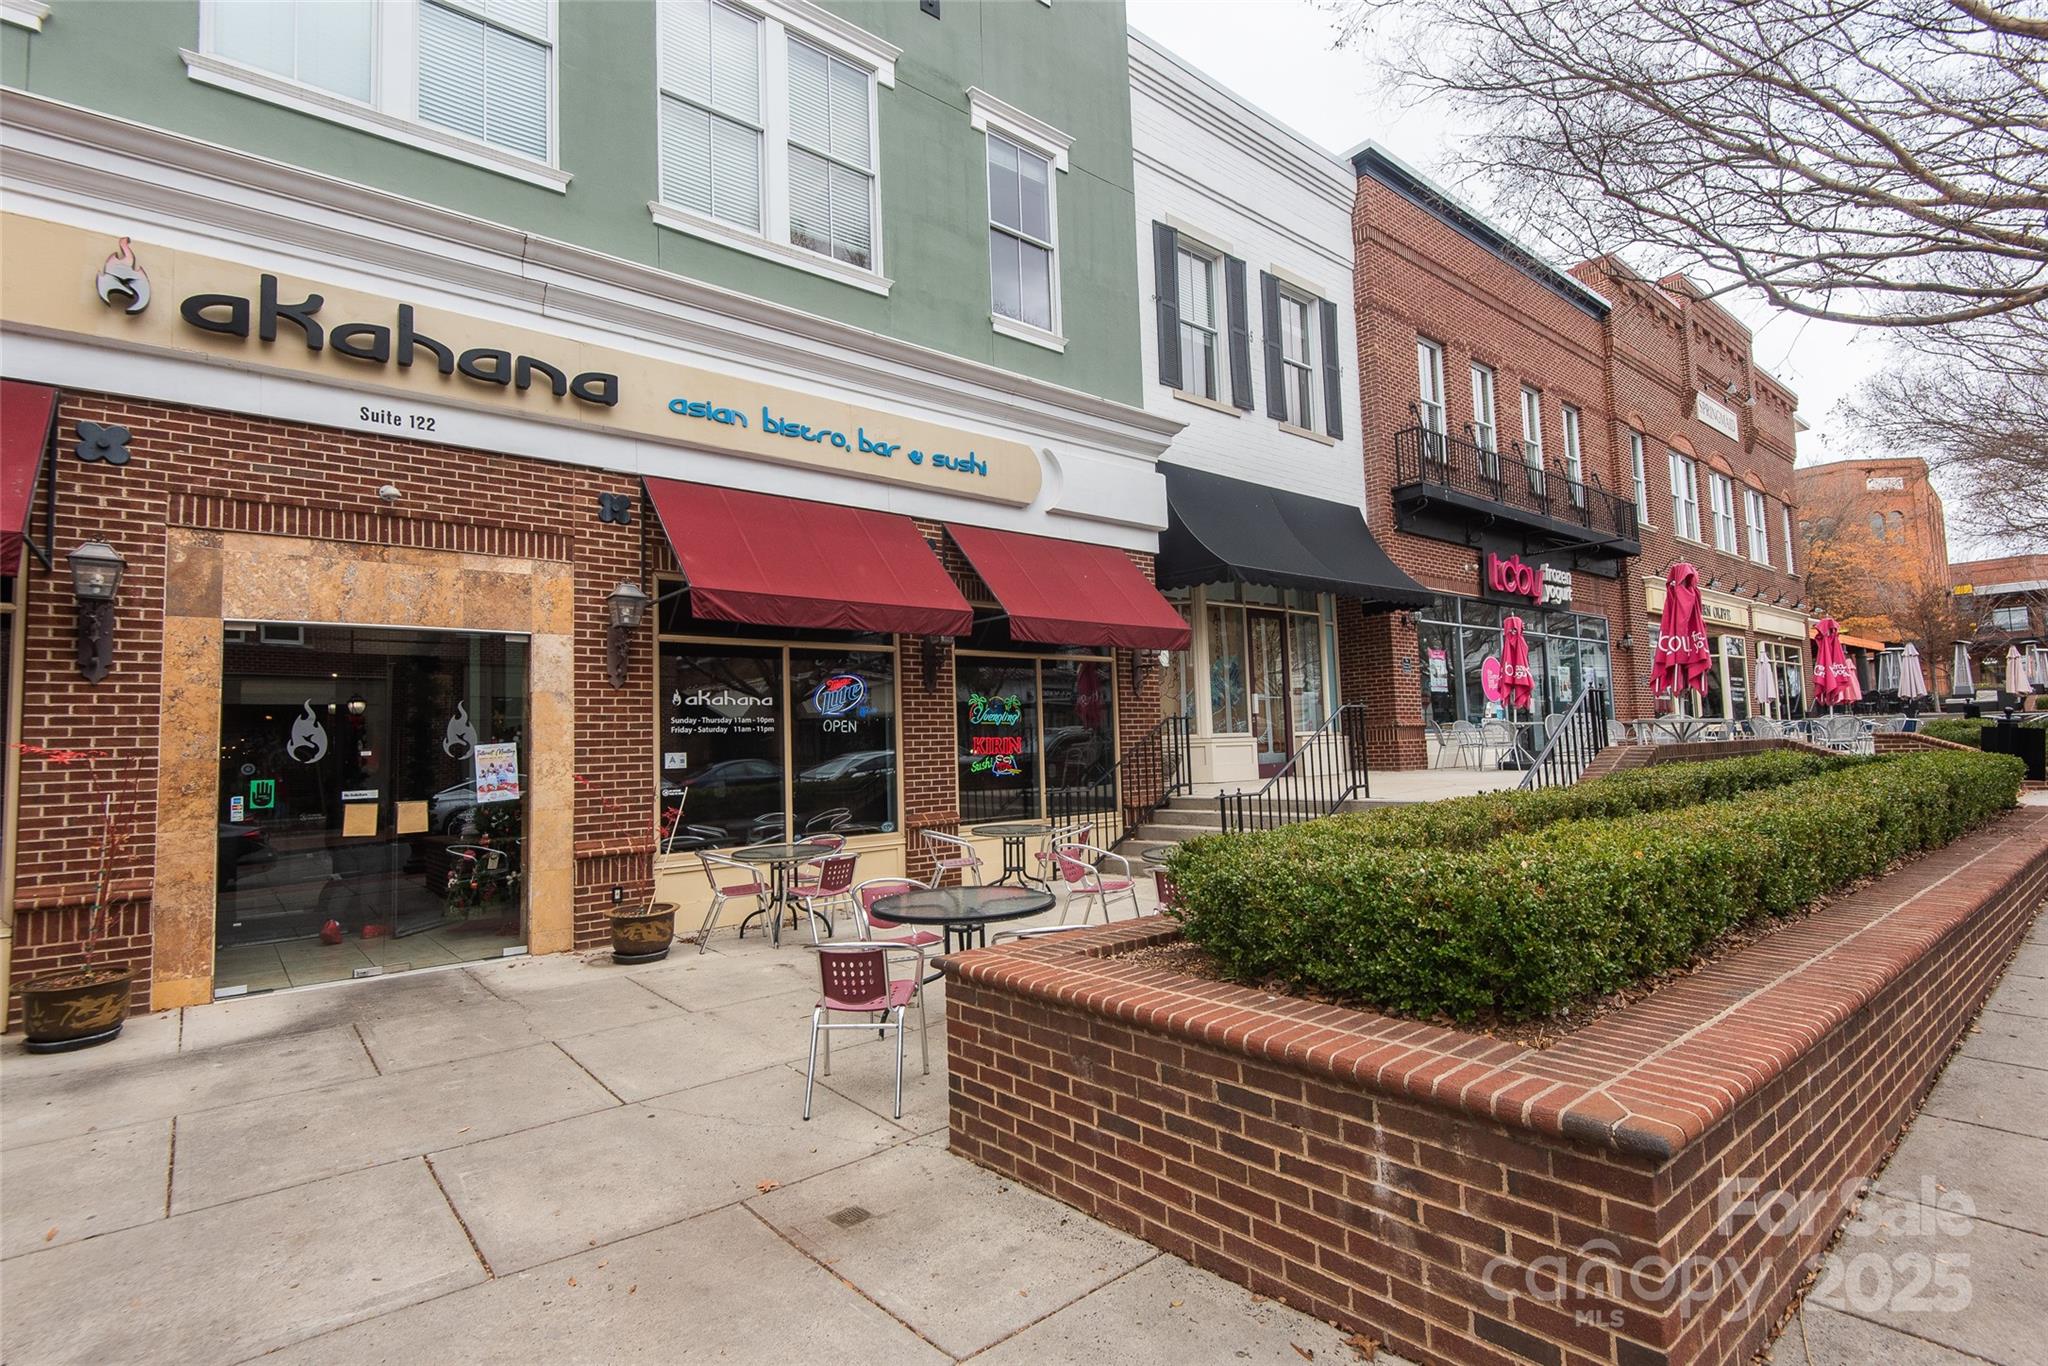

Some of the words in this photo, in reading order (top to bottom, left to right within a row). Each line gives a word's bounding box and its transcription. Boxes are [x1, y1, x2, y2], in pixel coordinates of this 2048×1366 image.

[360, 406, 402, 426] Suite
[409, 415, 436, 432] 122
[667, 397, 748, 428] asian
[762, 406, 851, 452] bistro,
[858, 427, 901, 457] bar
[932, 451, 987, 476] sushi
[1540, 563, 1572, 585] frozen
[1541, 584, 1573, 605] yogurt
[822, 683, 862, 715] Lite
[670, 716, 697, 725] Sunday
[701, 716, 733, 725] Thursday
[757, 716, 775, 725] 10pm
[823, 719, 857, 733] OPEN
[969, 705, 1020, 726] Yuengling
[670, 726, 693, 735] Friday
[697, 726, 728, 734] Saturday
[756, 725, 775, 733] 11pm
[973, 736, 1023, 755] KIRIN
[971, 756, 993, 773] Sushi
